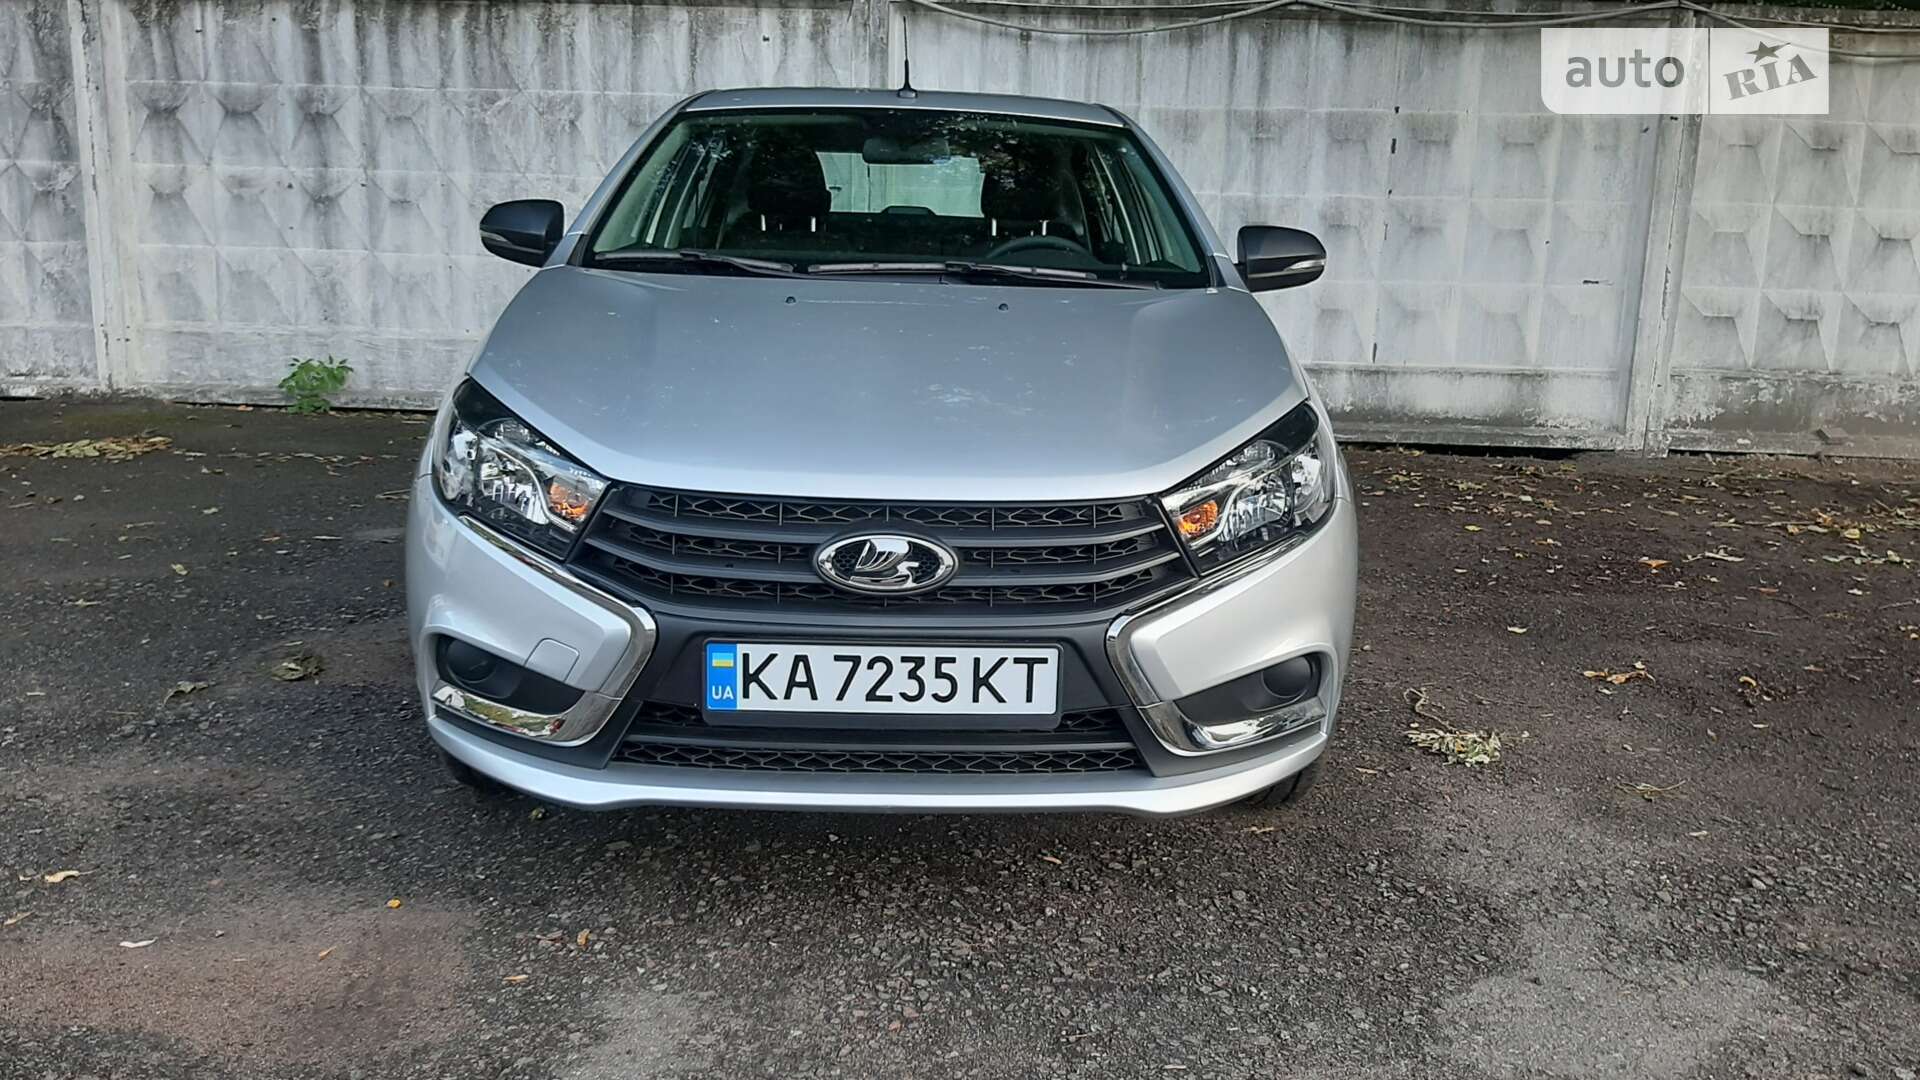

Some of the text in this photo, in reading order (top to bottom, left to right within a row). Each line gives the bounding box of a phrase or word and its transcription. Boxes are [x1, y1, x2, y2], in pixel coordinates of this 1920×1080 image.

[712, 686, 734, 700] UA
[742, 652, 1049, 703] KA 7235 KT
